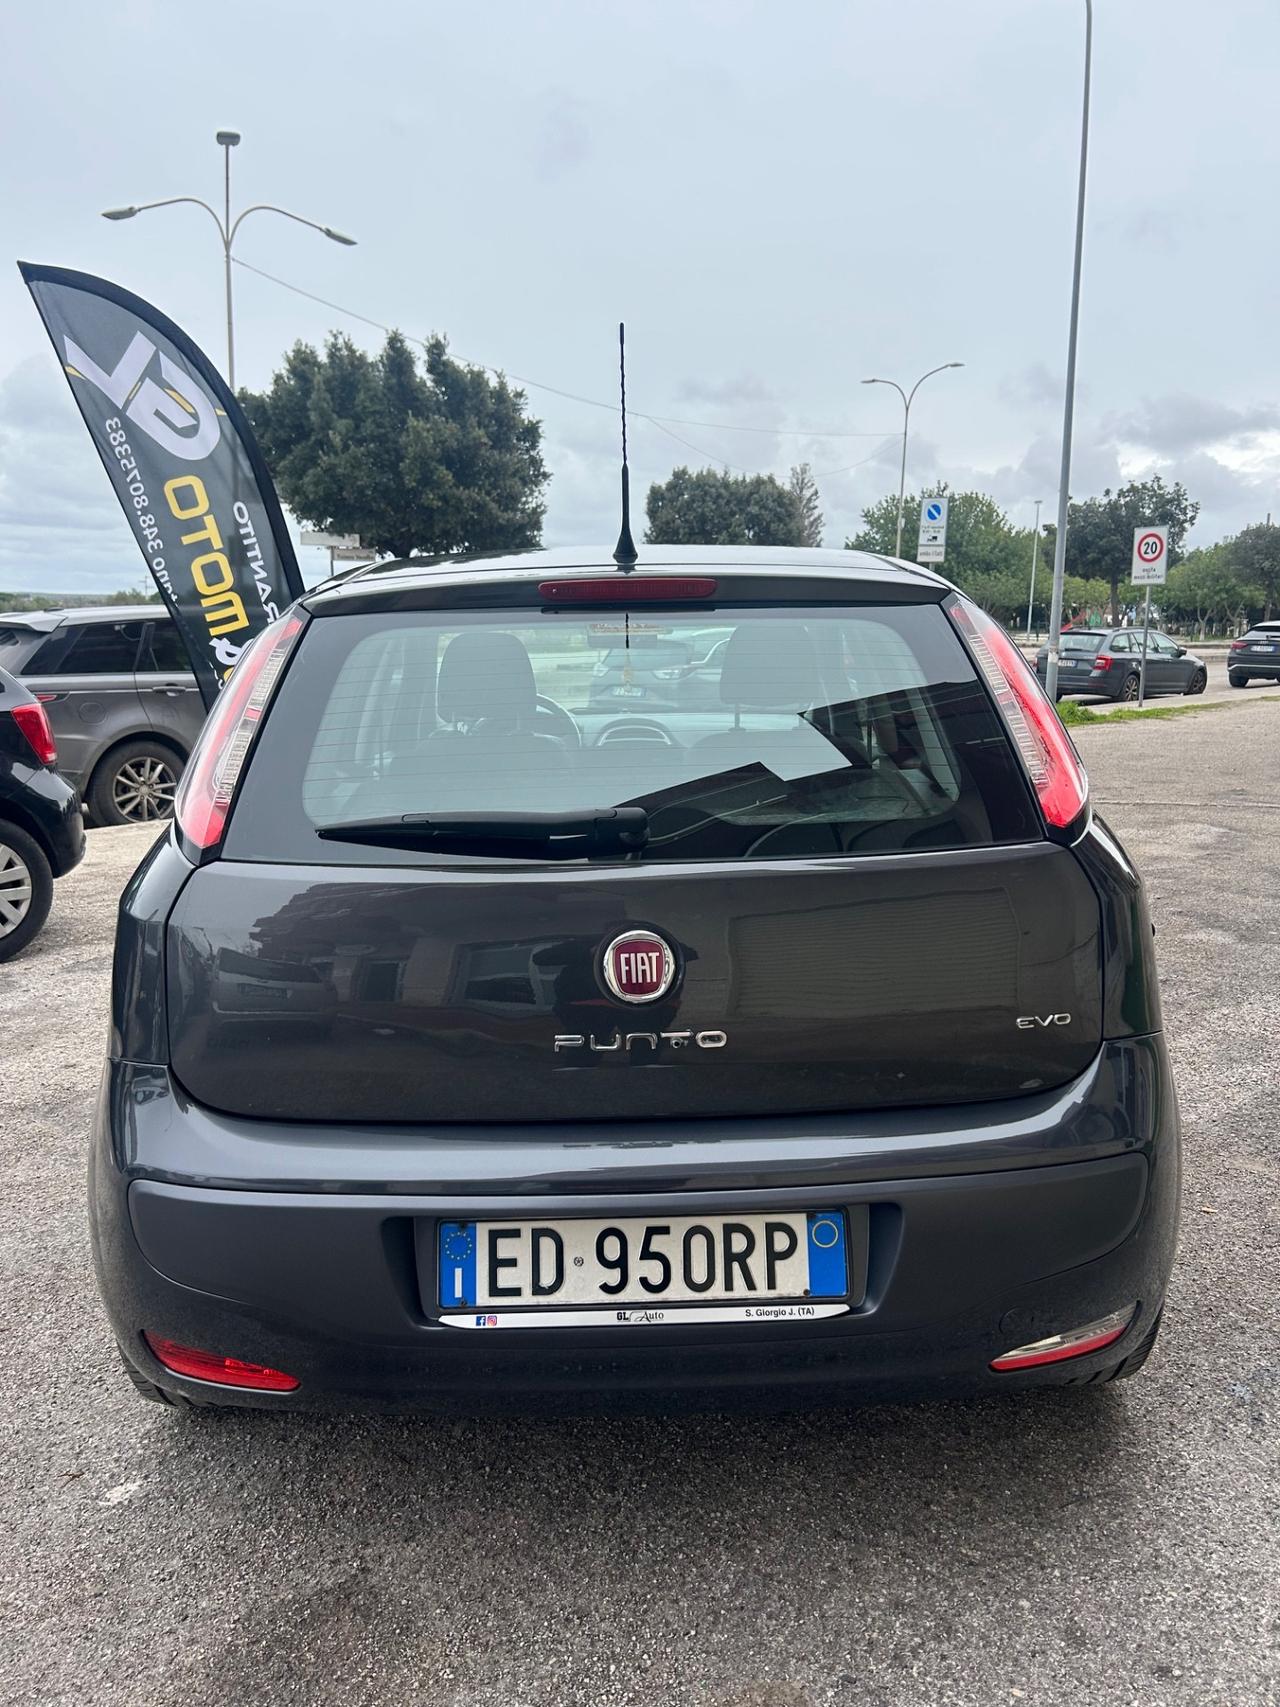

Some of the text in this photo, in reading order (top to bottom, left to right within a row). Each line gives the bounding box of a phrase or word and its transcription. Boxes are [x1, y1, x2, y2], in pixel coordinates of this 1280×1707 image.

[1143, 541, 1158, 555] 20
[620, 952, 660, 984] FIAT
[1016, 1013, 1071, 1028] EVO
[554, 1030, 728, 1052] PUNTO
[488, 1221, 799, 1297] ED 950RP
[616, 1311, 665, 1323] GL Auto
[745, 1306, 815, 1318] S. Giorgio J. (TA)
